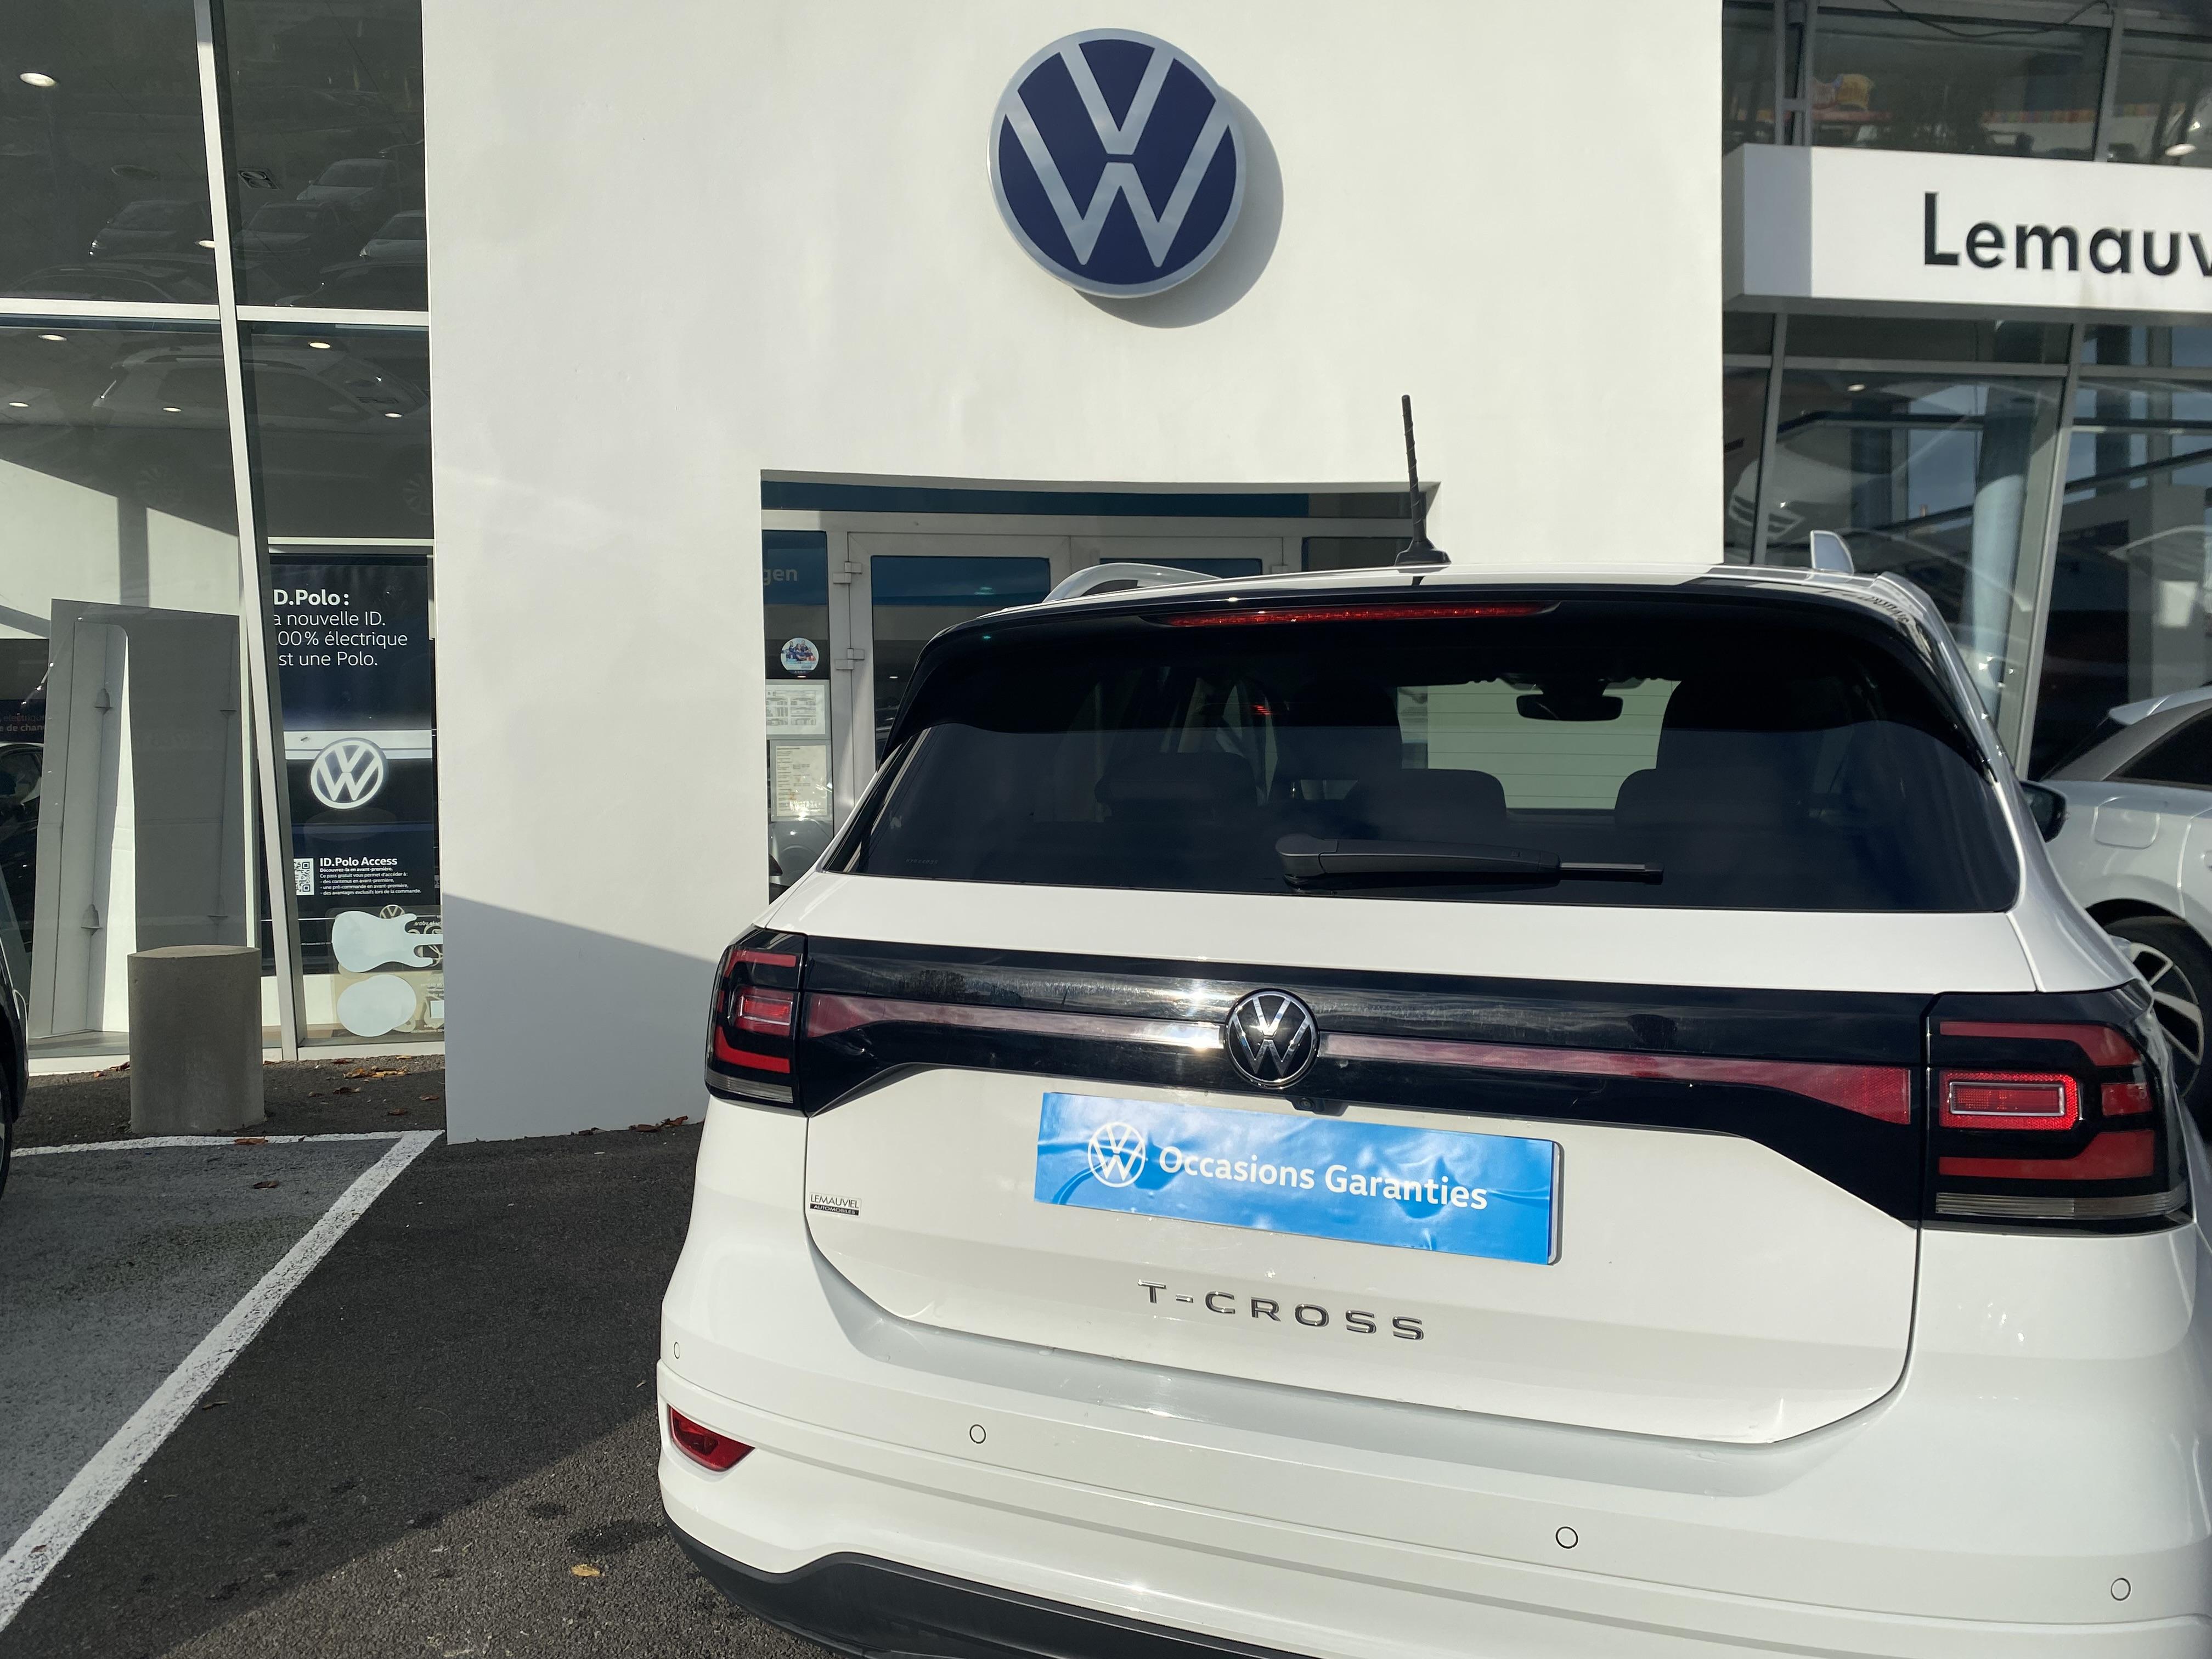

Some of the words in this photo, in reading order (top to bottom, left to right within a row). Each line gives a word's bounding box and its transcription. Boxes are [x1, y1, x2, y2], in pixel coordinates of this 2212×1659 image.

[1924, 192, 2212, 276] Lemauv
[287, 611, 359, 626] nouvelle
[365, 611, 386, 625] ID.
[276, 631, 319, 646] 00%
[325, 630, 408, 649] électrique
[299, 654, 331, 666] une
[337, 651, 378, 666] Polo.
[320, 857, 359, 866] ID.Polo
[360, 857, 398, 866] Access
[1159, 1146, 1315, 1189] Occasions
[1325, 1164, 1487, 1210] Garanties
[811, 1194, 859, 1209] LEMAUVIEL
[814, 1204, 855, 1215] AUTOMOBILES
[1138, 1280, 1424, 1340] T-CROSS
